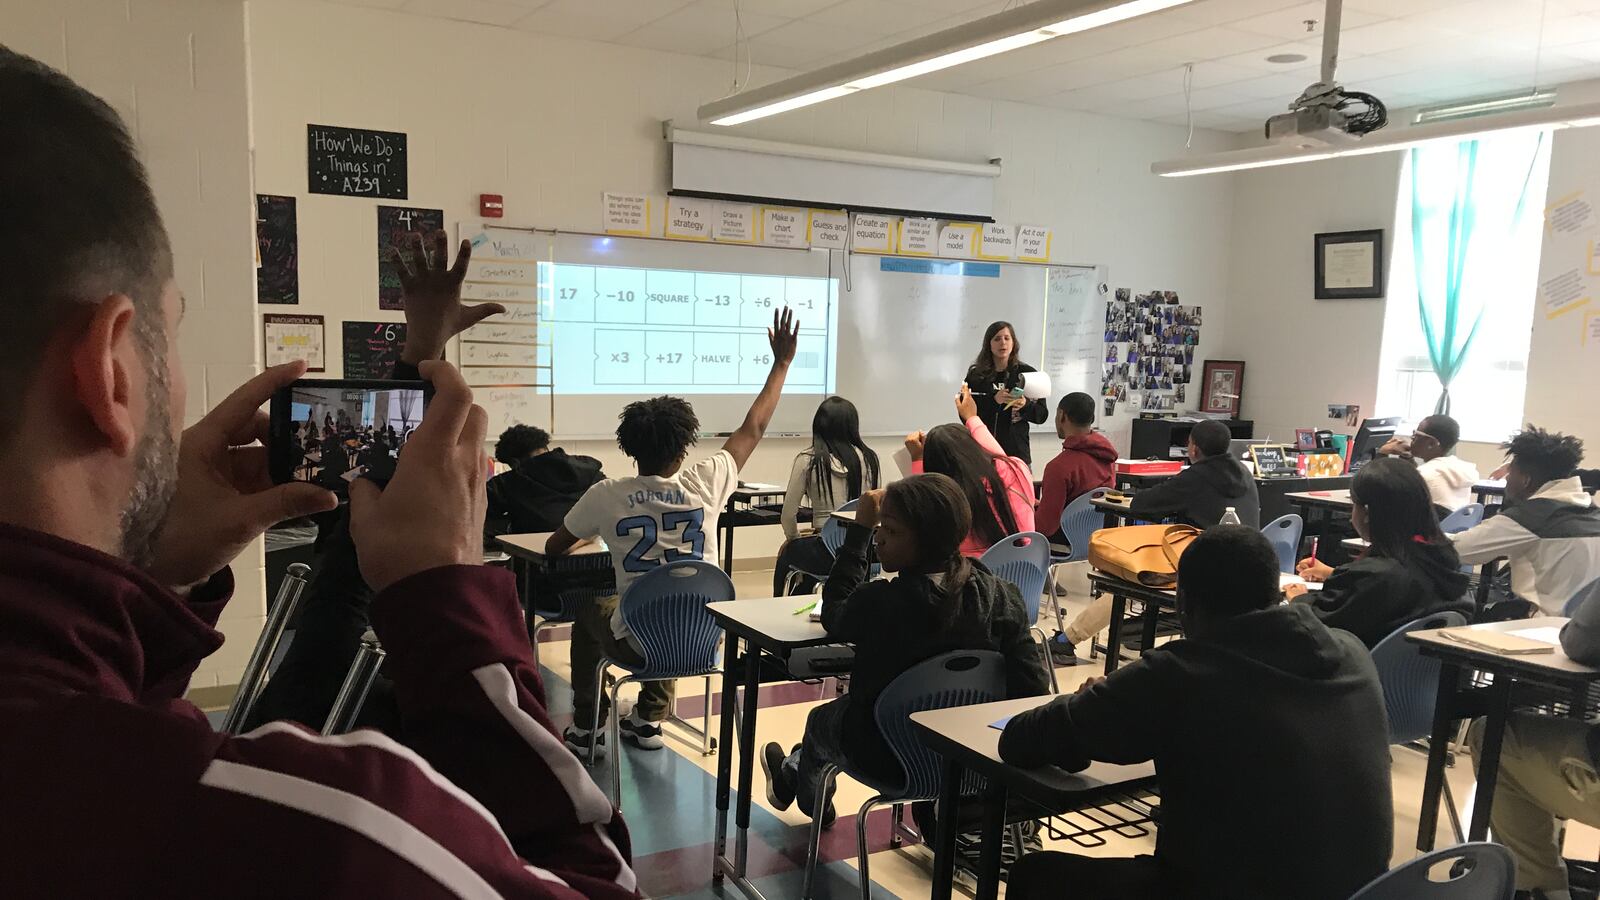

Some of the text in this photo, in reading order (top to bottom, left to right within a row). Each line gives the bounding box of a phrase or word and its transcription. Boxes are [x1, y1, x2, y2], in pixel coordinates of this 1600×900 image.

[315, 130, 393, 156] How We Do
[327, 154, 387, 178] Things in
[342, 176, 380, 195] A239
[680, 207, 692, 218] Try
[771, 213, 789, 222] Make
[673, 219, 704, 231] strategy
[812, 219, 847, 232] Guess and
[856, 217, 878, 228] Create
[774, 224, 791, 233] chart
[1022, 228, 1031, 236] Act
[820, 232, 839, 241] check
[856, 230, 886, 240] equation
[948, 232, 959, 240] Use
[983, 235, 1012, 245] backwards
[1024, 247, 1037, 255] mind
[559, 288, 814, 309] 17 -10 SQUARE -13 ÷6 -1
[656, 353, 683, 364] +17
[701, 354, 731, 364] HALVE
[753, 354, 770, 365] +6
[627, 489, 686, 508] JORDAN
[616, 507, 706, 573] 23
